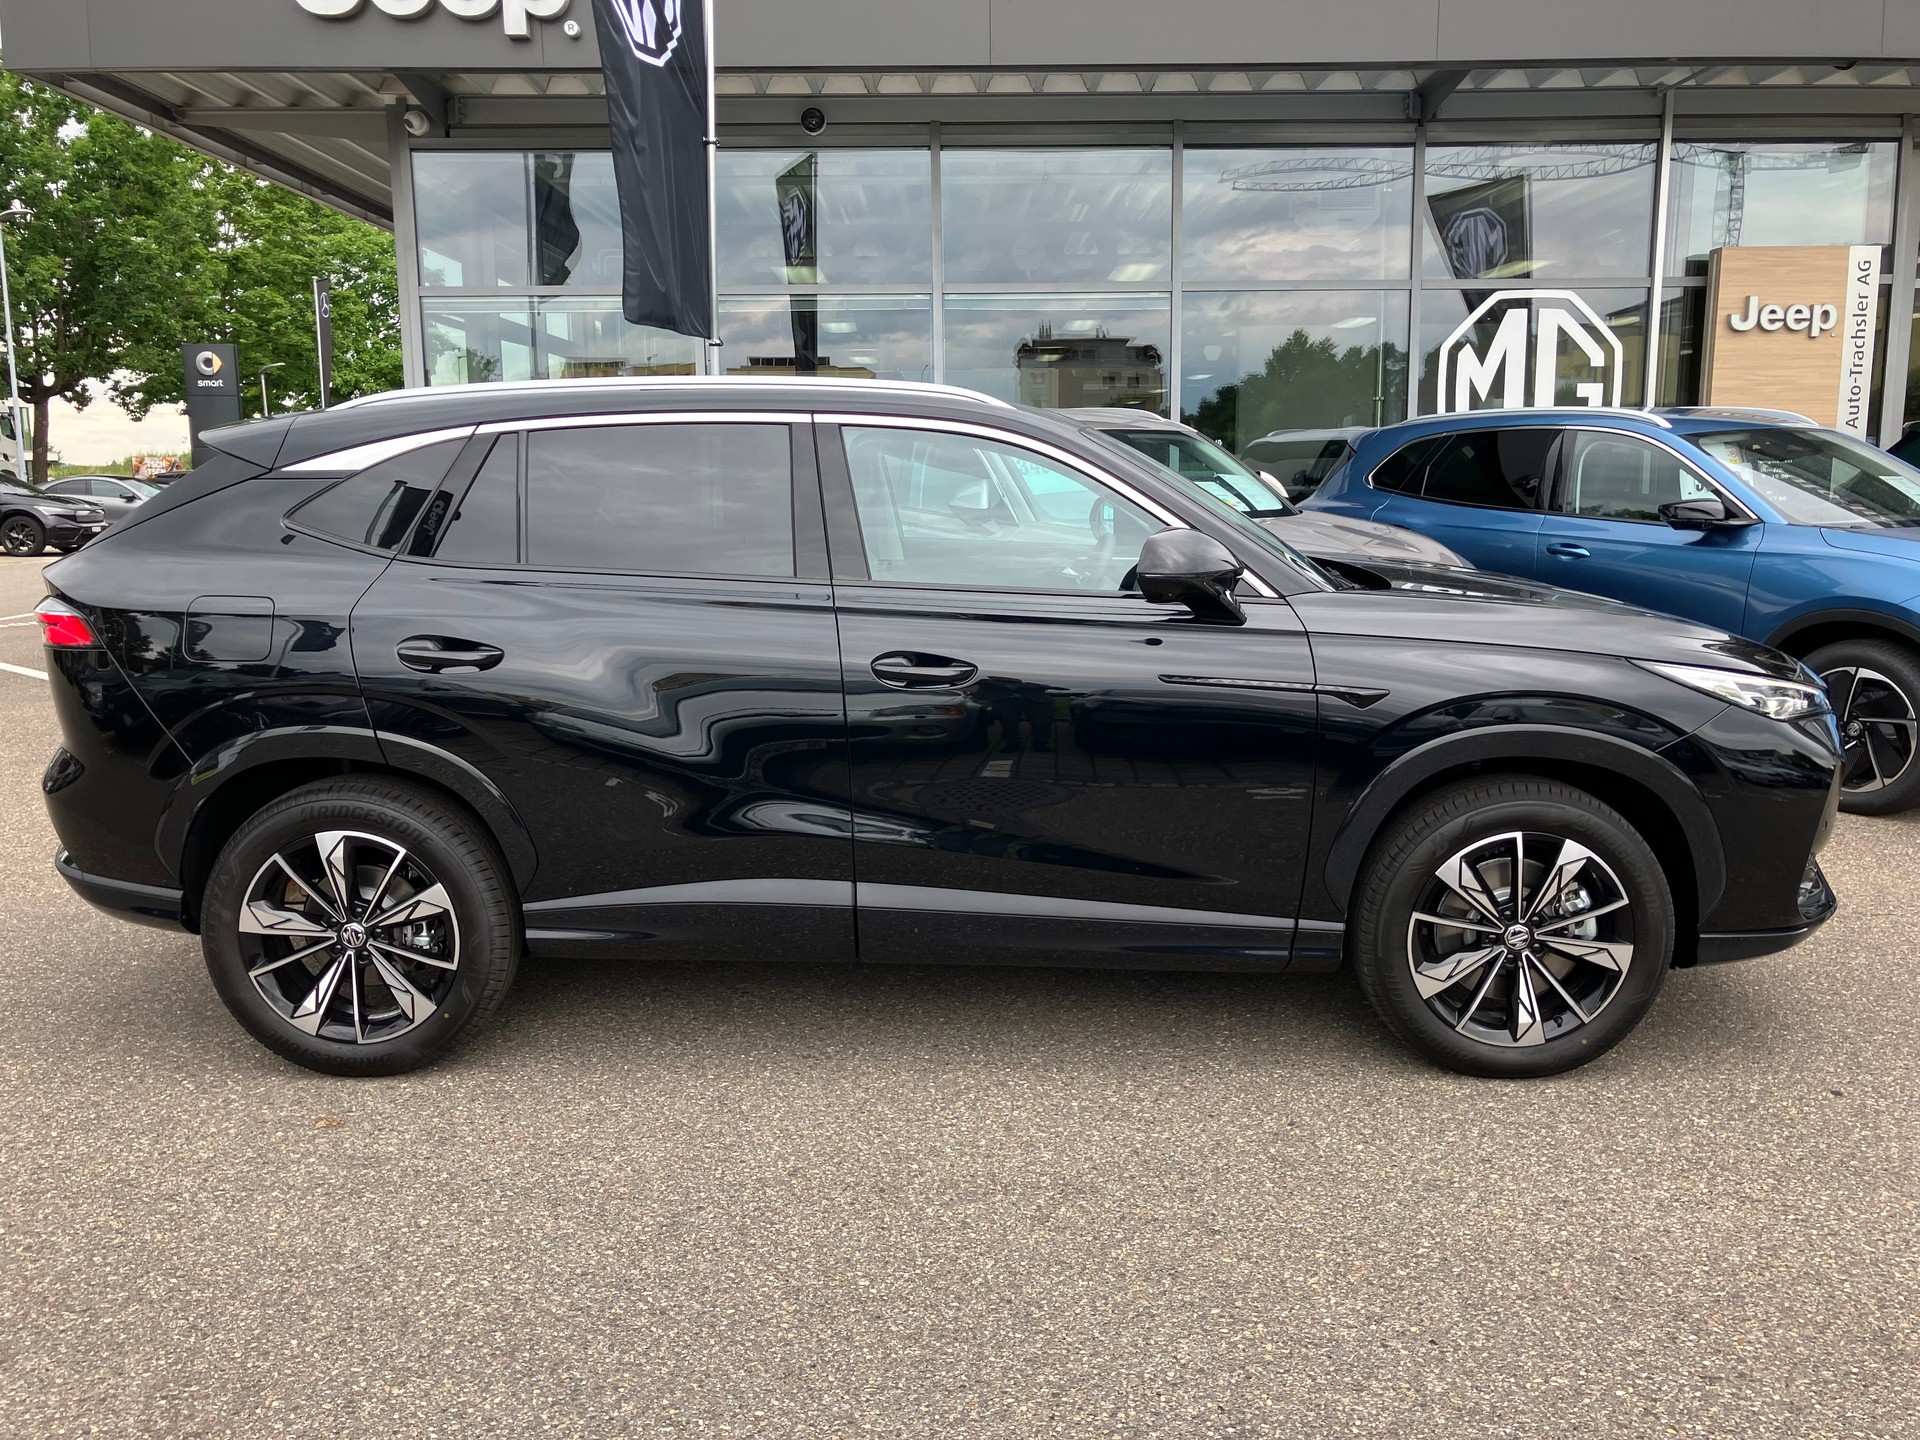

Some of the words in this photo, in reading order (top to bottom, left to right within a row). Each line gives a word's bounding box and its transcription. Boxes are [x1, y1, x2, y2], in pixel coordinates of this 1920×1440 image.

[1856, 259, 1872, 286] AG
[1728, 295, 1838, 338] Jeep
[1455, 307, 1605, 412] MG
[1845, 292, 1869, 429] Auto-Trachsler
[197, 379, 224, 387] smart
[146, 460, 166, 468] TSCH
[423, 500, 445, 536] Jeep
